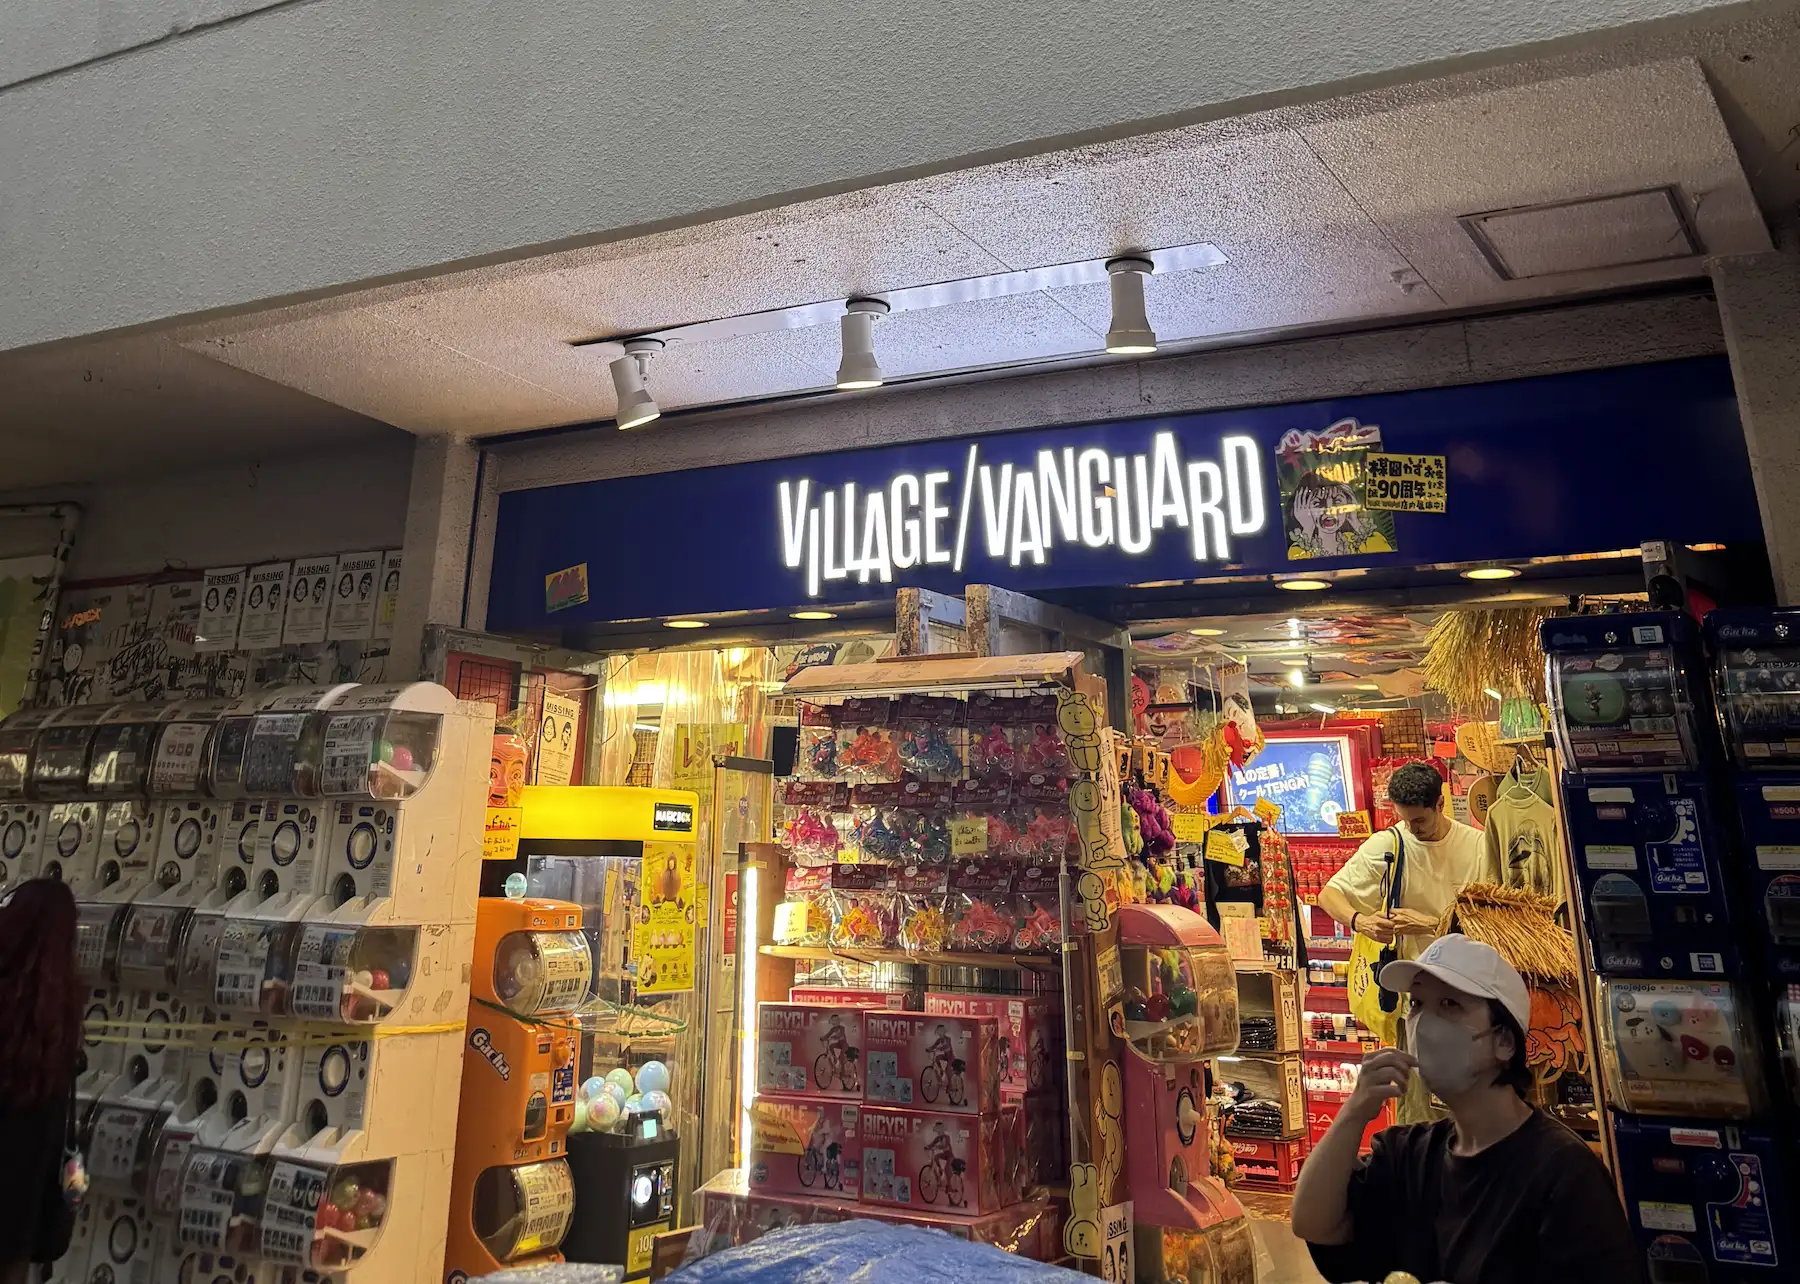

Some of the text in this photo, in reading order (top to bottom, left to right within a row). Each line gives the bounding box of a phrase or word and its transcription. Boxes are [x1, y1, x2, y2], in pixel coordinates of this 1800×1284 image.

[297, 564, 330, 576] MISSING
[342, 559, 376, 570] MISSING
[207, 574, 240, 585] MISSING
[252, 571, 284, 582] MISSING
[546, 702, 575, 718] MISSING
[1614, 983, 1656, 993] mojojojo
[927, 998, 978, 1015] BICYCLE
[761, 1010, 819, 1029] BICYCLE
[867, 1018, 925, 1039] BICYCLE
[863, 1113, 923, 1136] BICYCLE
